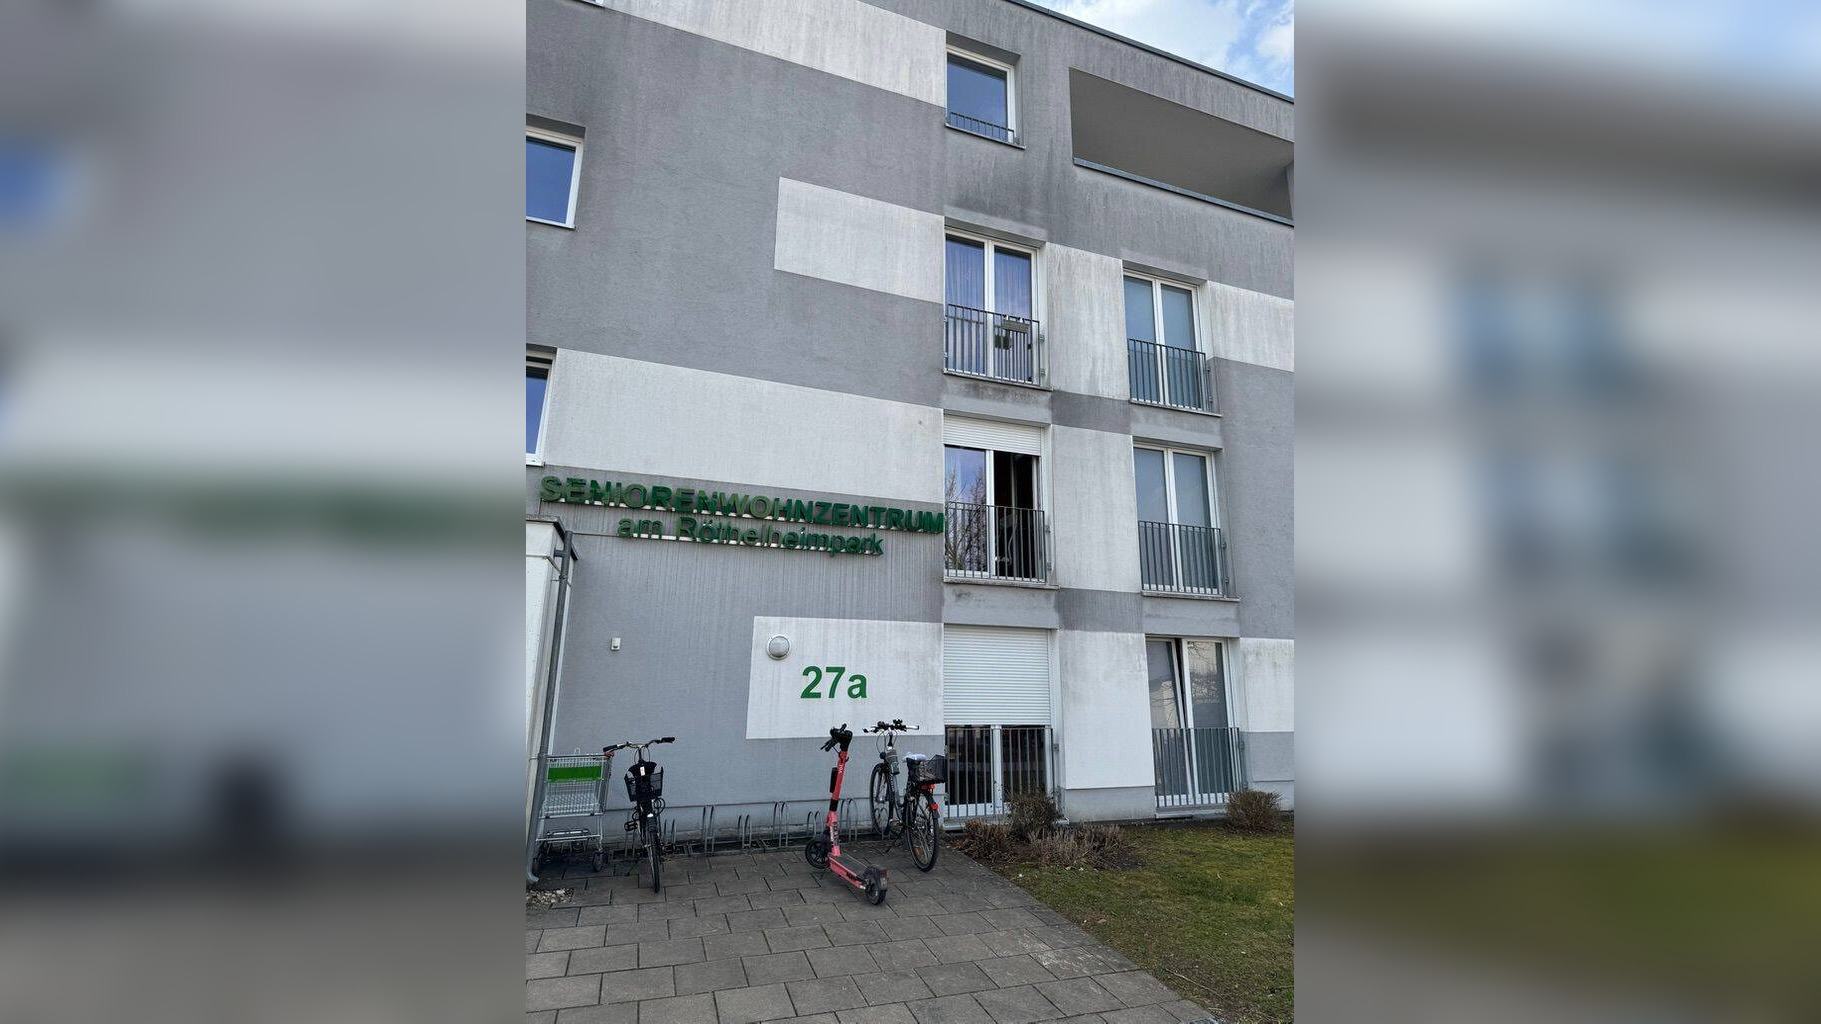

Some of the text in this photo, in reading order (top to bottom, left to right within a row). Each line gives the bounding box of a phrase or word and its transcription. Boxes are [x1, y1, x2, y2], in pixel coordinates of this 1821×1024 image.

[540, 475, 944, 534] SENIORENWOHNZENTRUM
[617, 516, 883, 557] am Röthelheimpark
[801, 665, 868, 699] 27a
